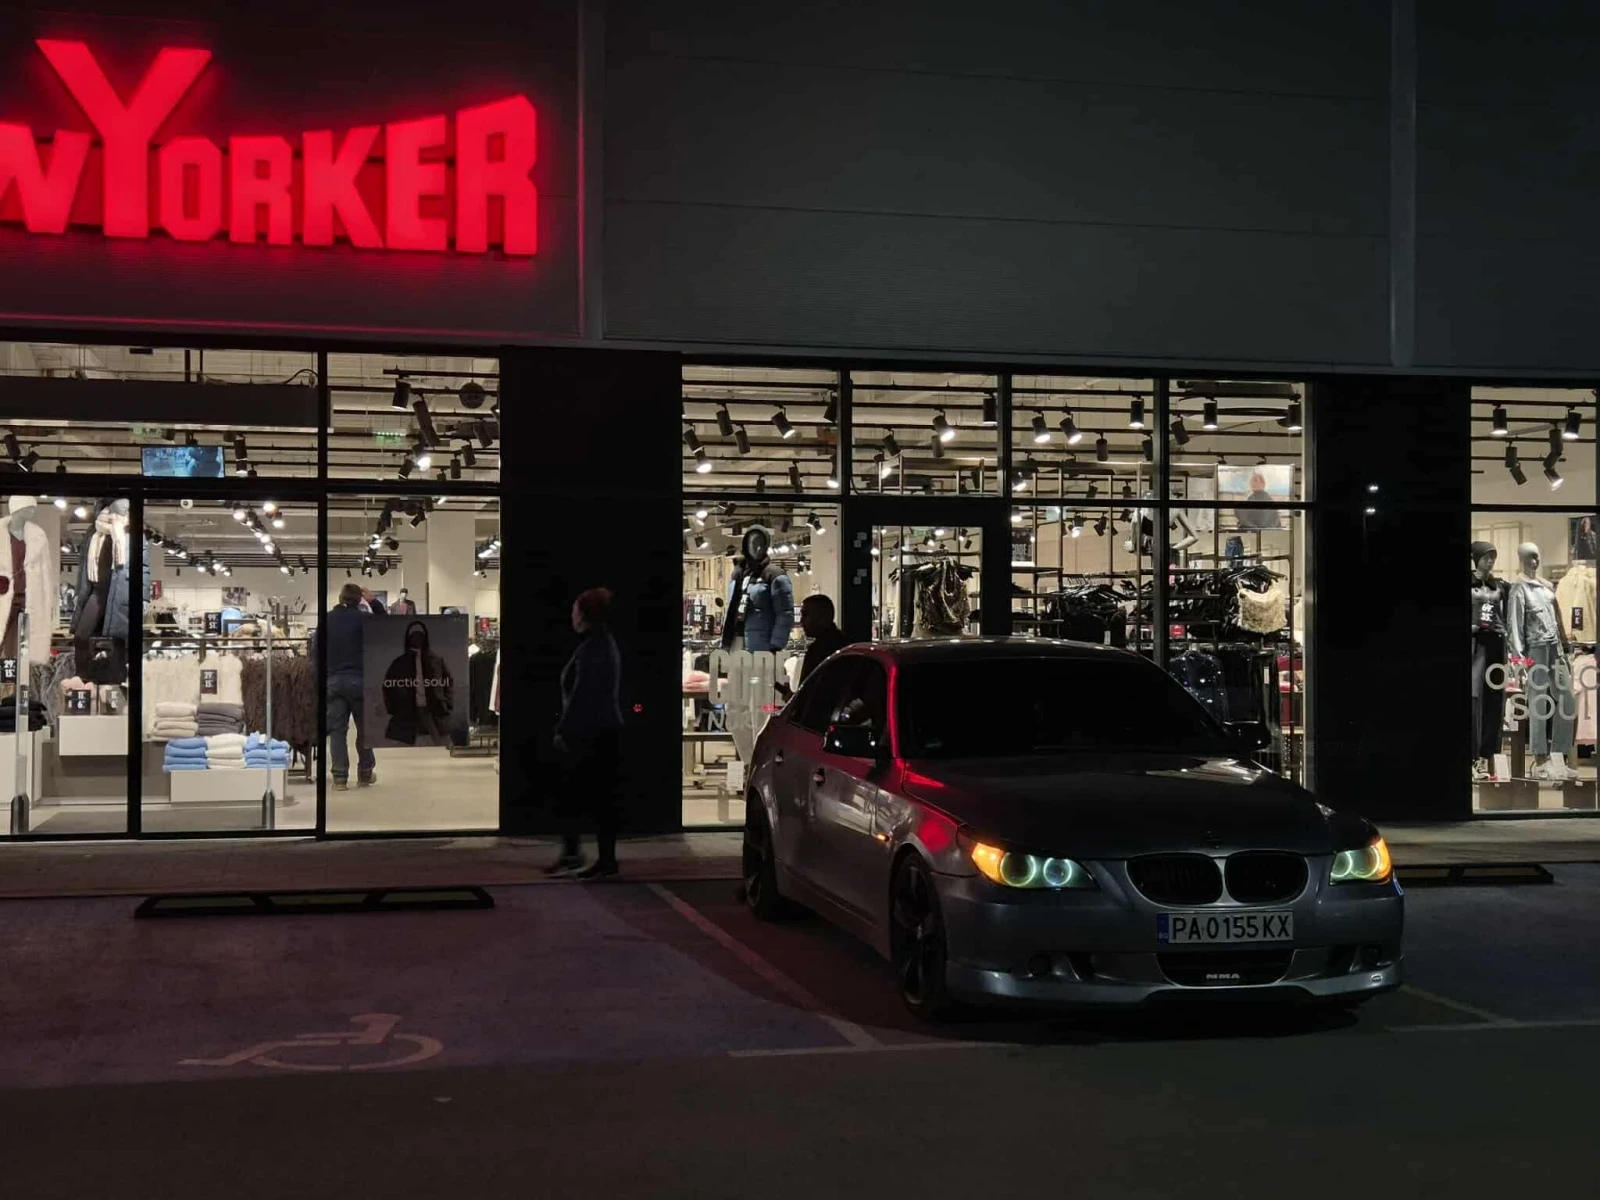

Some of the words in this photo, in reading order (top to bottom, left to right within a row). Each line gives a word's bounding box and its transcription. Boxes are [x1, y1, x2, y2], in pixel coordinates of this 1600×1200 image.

[384, 676, 420, 688] arctic
[424, 675, 450, 688] soul
[1510, 687, 1591, 721] soul
